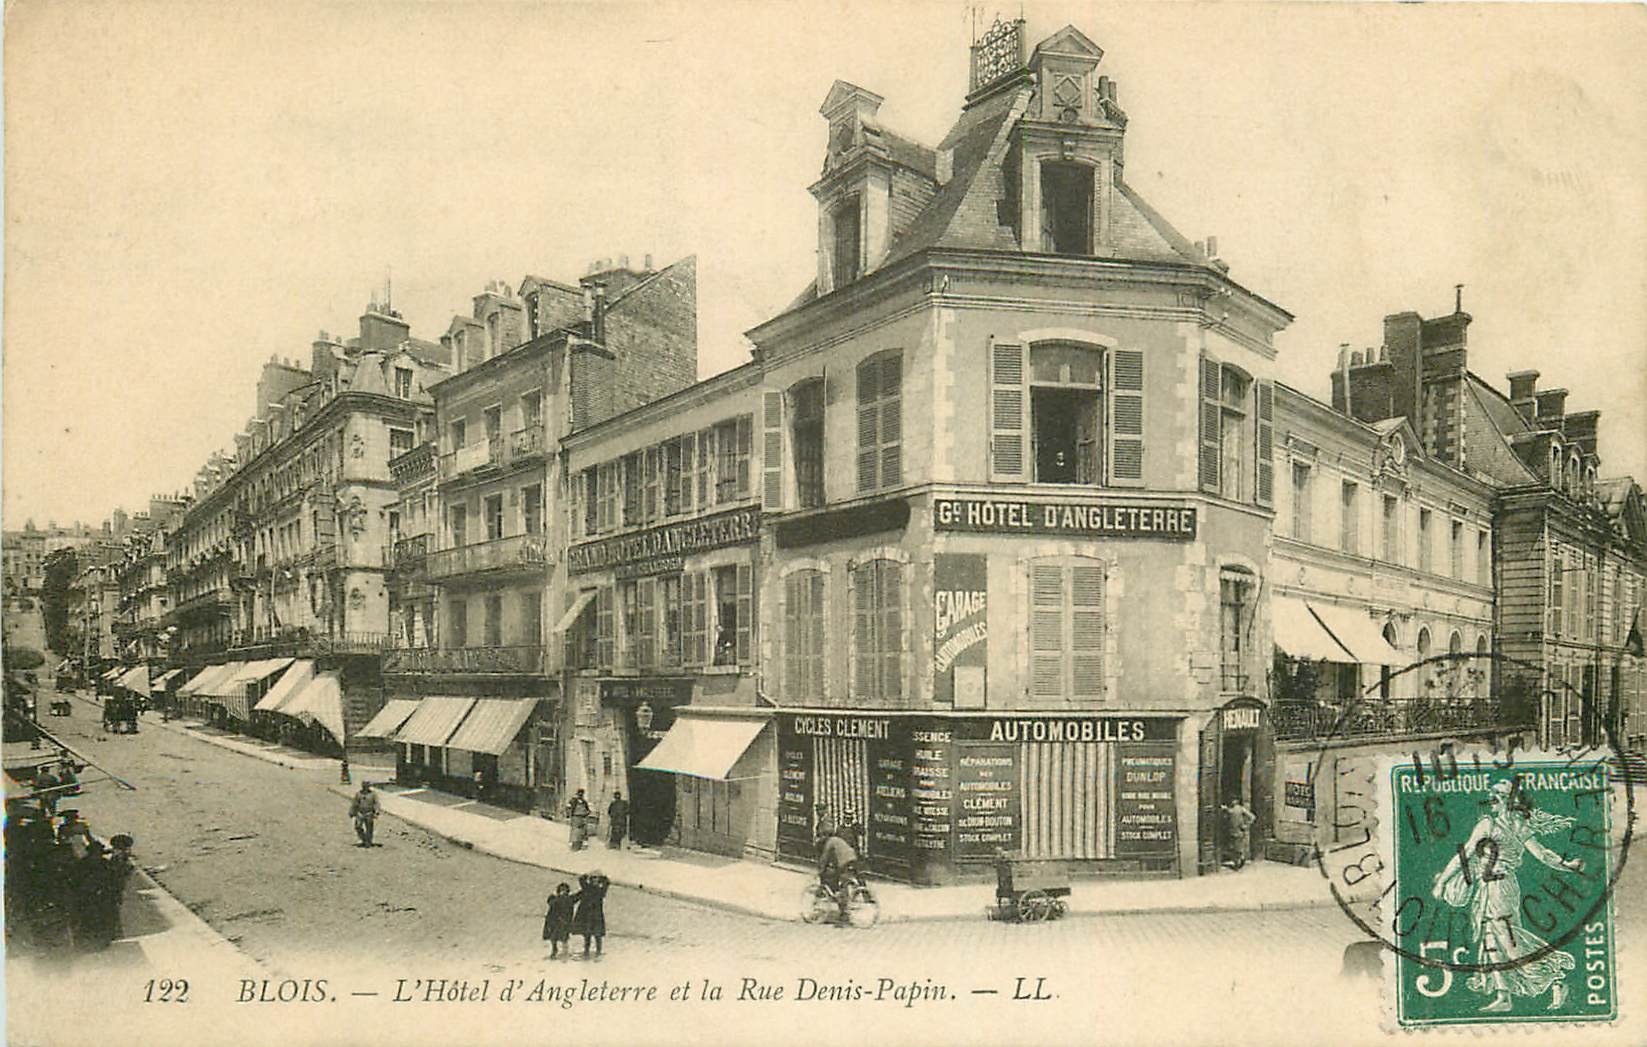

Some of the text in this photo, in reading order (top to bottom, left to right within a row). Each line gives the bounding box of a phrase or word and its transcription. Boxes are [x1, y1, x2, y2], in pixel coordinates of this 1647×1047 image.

[1044, 506, 1193, 532] D'ANGLETERRE
[935, 591, 987, 638] GARAGE
[795, 717, 832, 735] CYCLES
[990, 720, 1145, 742] AUTOMOBILES
[1126, 771, 1168, 783] DUNLOP
[1584, 921, 1607, 1005] POSTES
